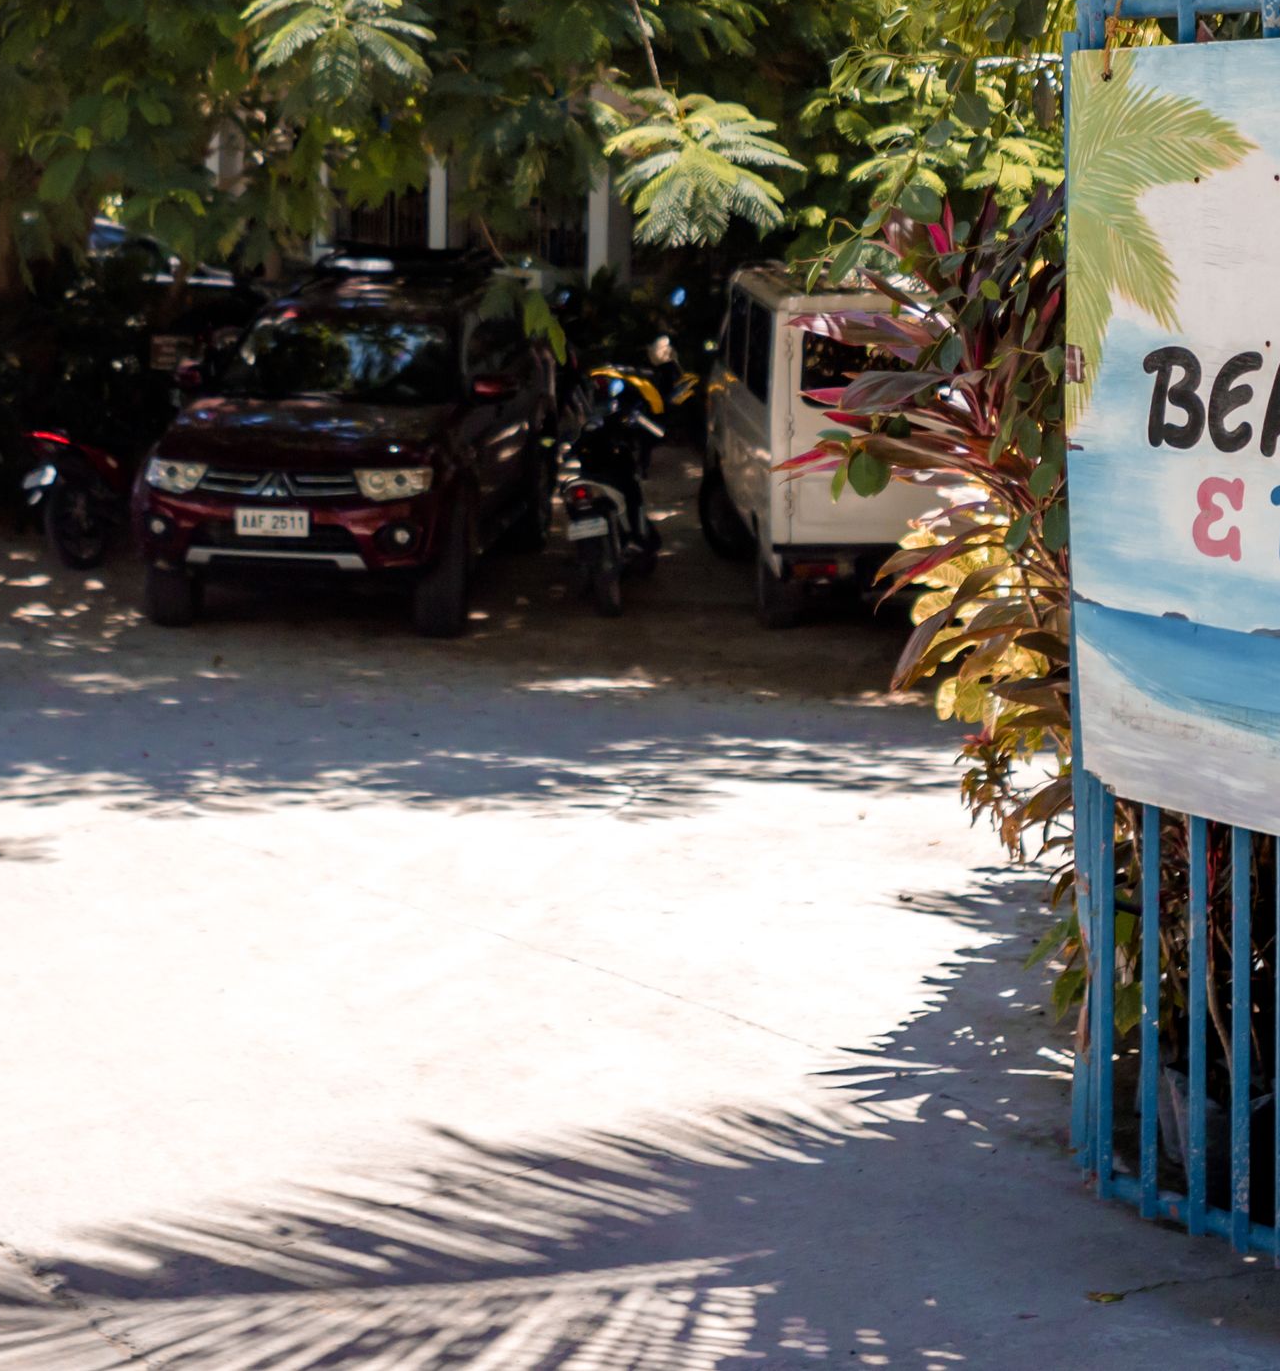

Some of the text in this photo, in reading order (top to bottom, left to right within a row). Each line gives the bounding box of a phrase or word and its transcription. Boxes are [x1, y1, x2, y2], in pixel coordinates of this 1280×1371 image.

[241, 514, 304, 530] AAF 2511
[1192, 477, 1246, 563] &
